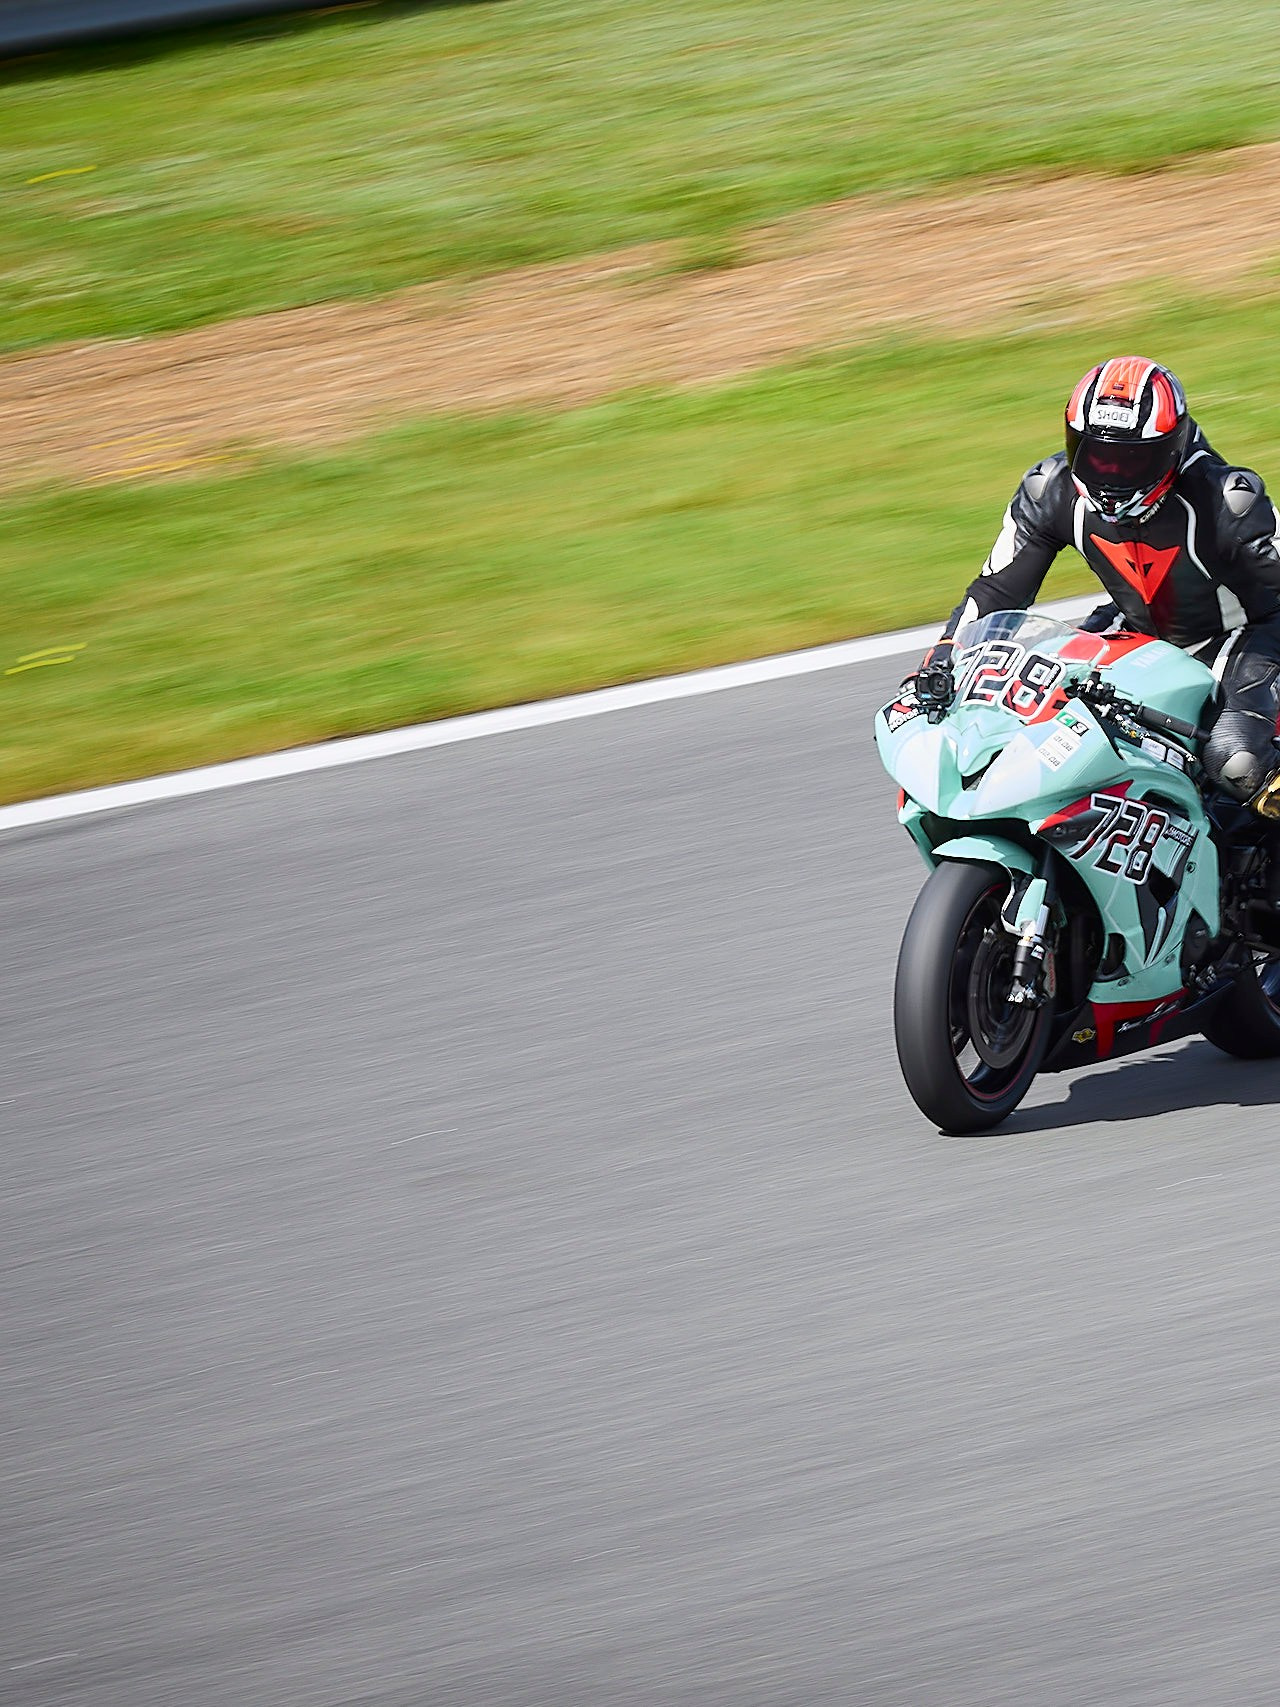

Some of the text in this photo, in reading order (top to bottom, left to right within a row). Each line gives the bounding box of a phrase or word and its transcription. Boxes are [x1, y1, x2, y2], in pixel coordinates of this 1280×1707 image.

[888, 707, 925, 731] MOTOR
[953, 639, 1067, 720] 728
[1067, 792, 1170, 885] 728
